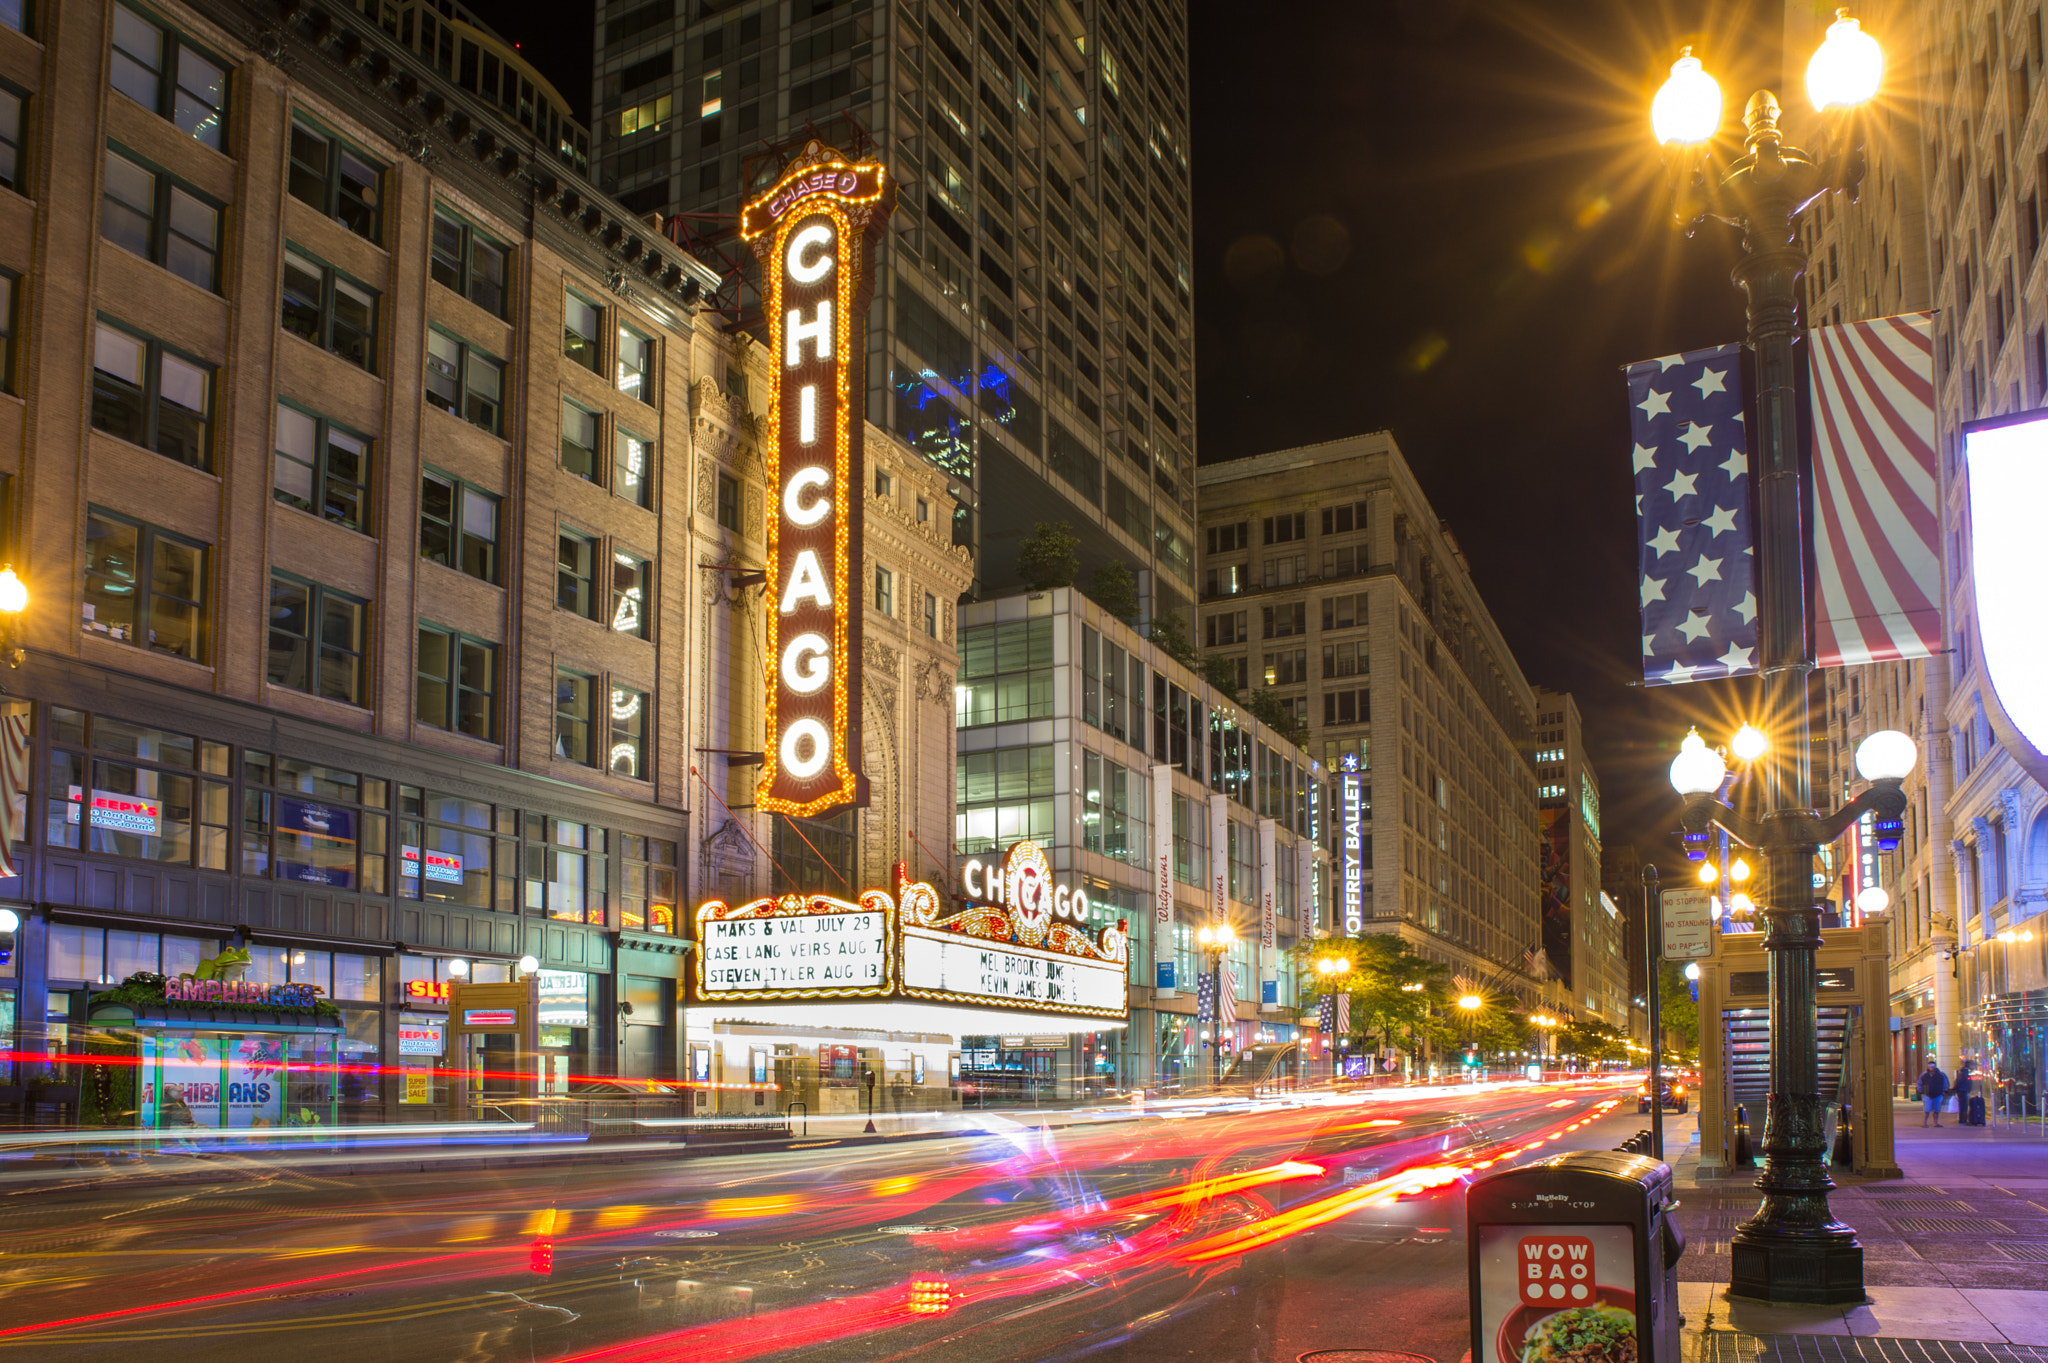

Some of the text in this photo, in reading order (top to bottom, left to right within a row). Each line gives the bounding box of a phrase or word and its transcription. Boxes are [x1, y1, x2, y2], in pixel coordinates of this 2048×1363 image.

[768, 172, 837, 217] CHASE
[781, 224, 833, 779] CHICAGO
[1345, 776, 1360, 849] BALLET
[964, 859, 1089, 922] CHICAGO
[1158, 854, 1172, 924] Walgreens
[1676, 896, 1708, 905] STOPPING
[716, 916, 870, 938] MAKS & VAL JULY 29
[1263, 892, 1275, 950] Walgreens
[1677, 919, 1709, 928] STANDING
[746, 944, 781, 959] LANG
[790, 942, 831, 957] VEIRS
[838, 940, 866, 955] AUG
[875, 938, 882, 954] 7
[710, 963, 877, 983] STEVEN TYLER AUG 13
[980, 951, 998, 973] MEL
[1004, 955, 1040, 978] BROOKS
[1045, 962, 1065, 982] JUNE
[980, 974, 1008, 995] KEVIN
[1014, 979, 1042, 998] JAMES
[1046, 982, 1066, 1001] JUNE
[408, 1089, 426, 1097] SALE
[1536, 1194, 1569, 1202] BigBelly
[1524, 1244, 1588, 1260] WOW
[1527, 1263, 1588, 1279] BAO
